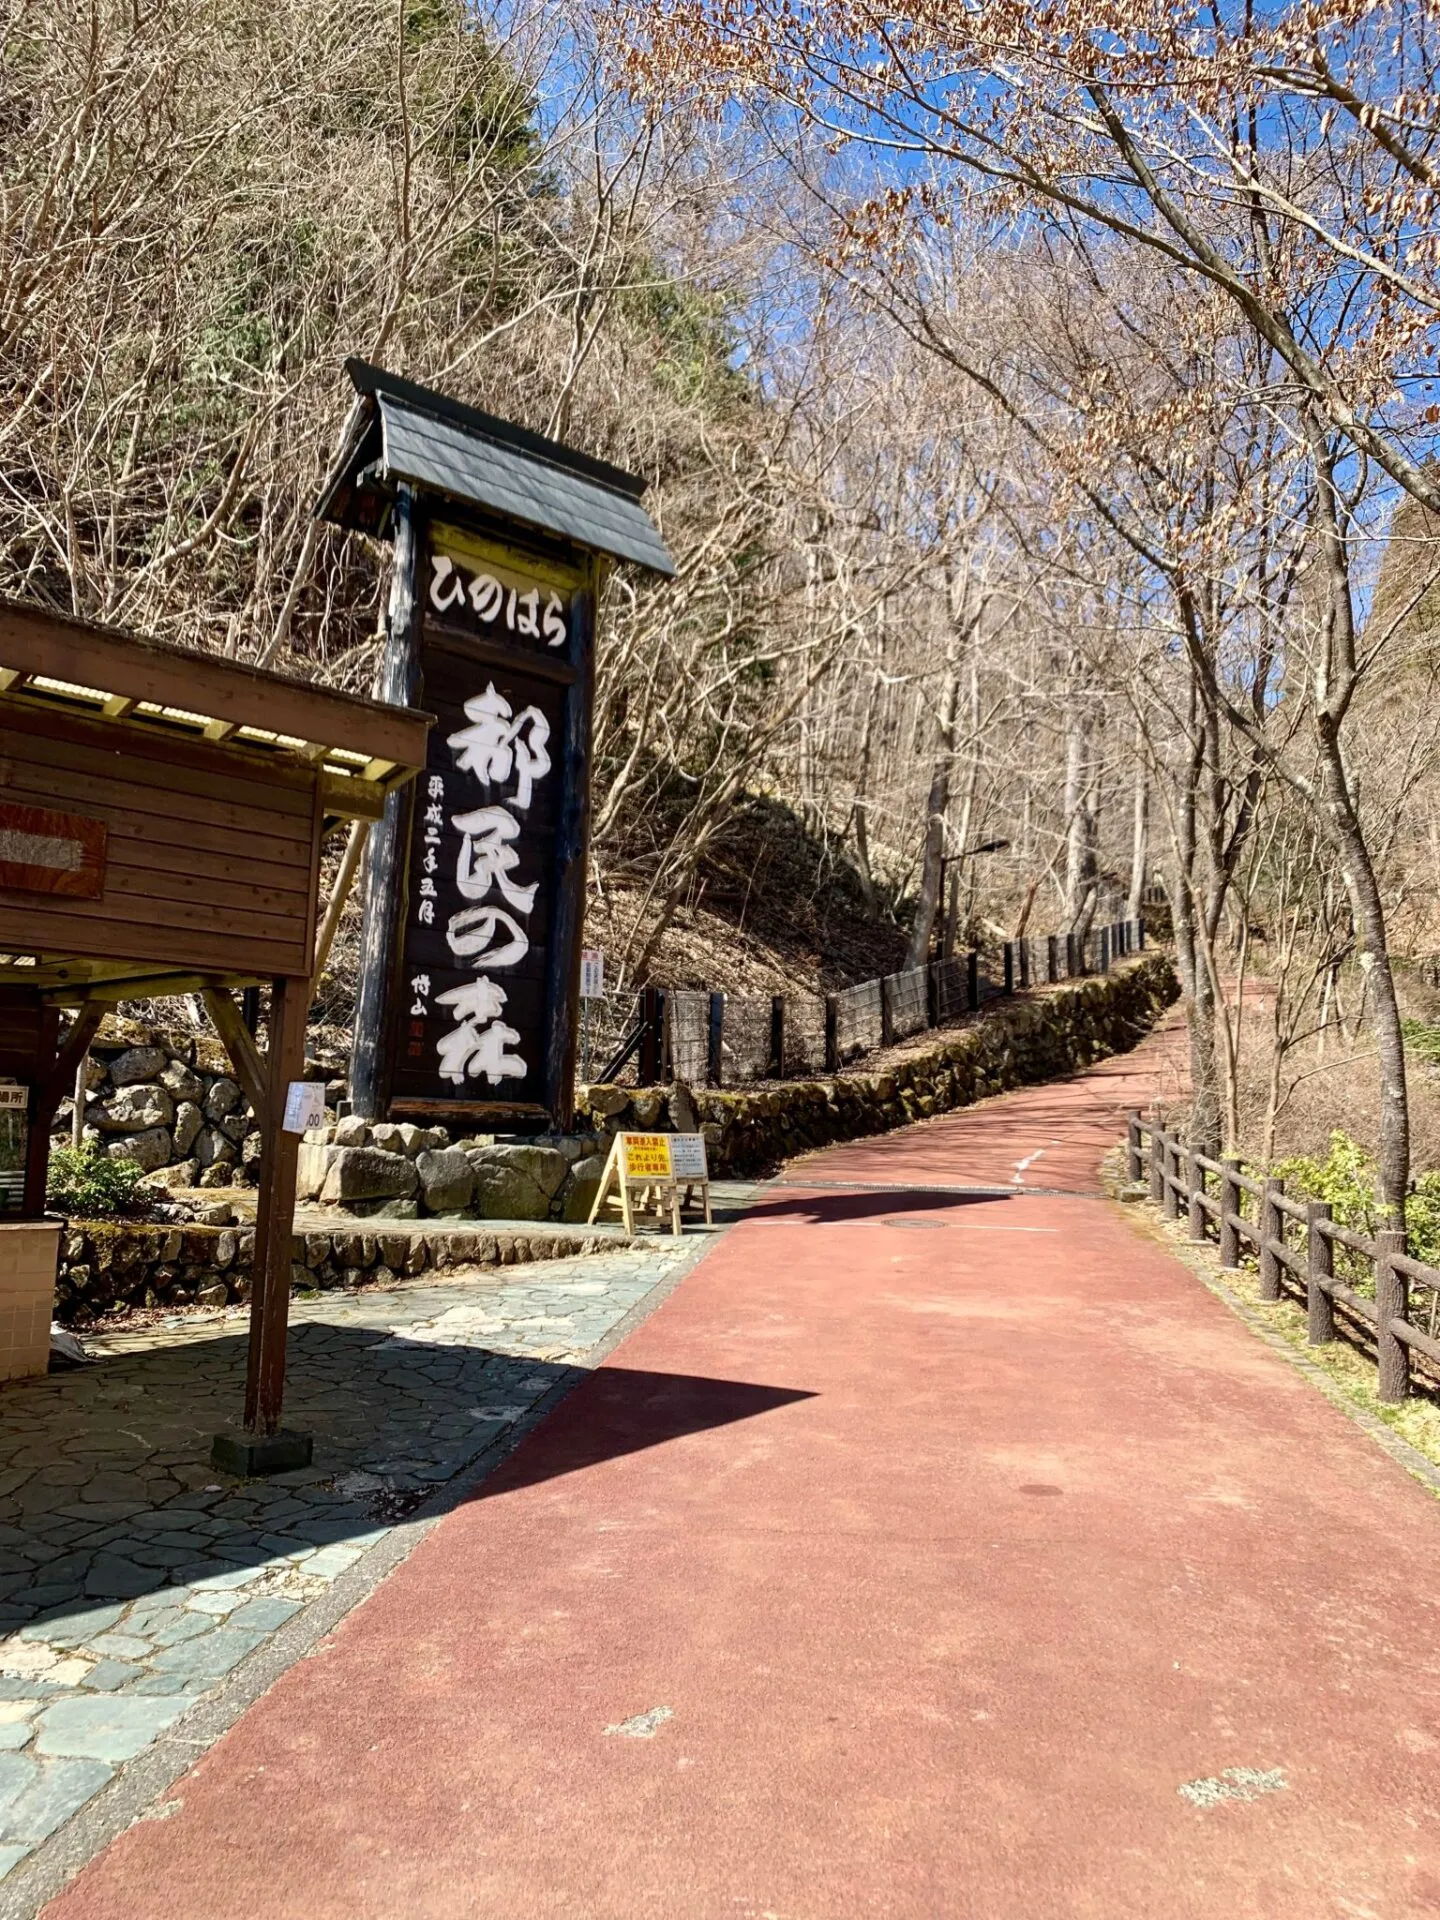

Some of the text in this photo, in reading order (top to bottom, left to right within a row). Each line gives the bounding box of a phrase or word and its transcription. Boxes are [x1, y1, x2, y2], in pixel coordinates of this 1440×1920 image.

[430, 556, 567, 646] ひのはら
[434, 681, 552, 1086] 都民の森
